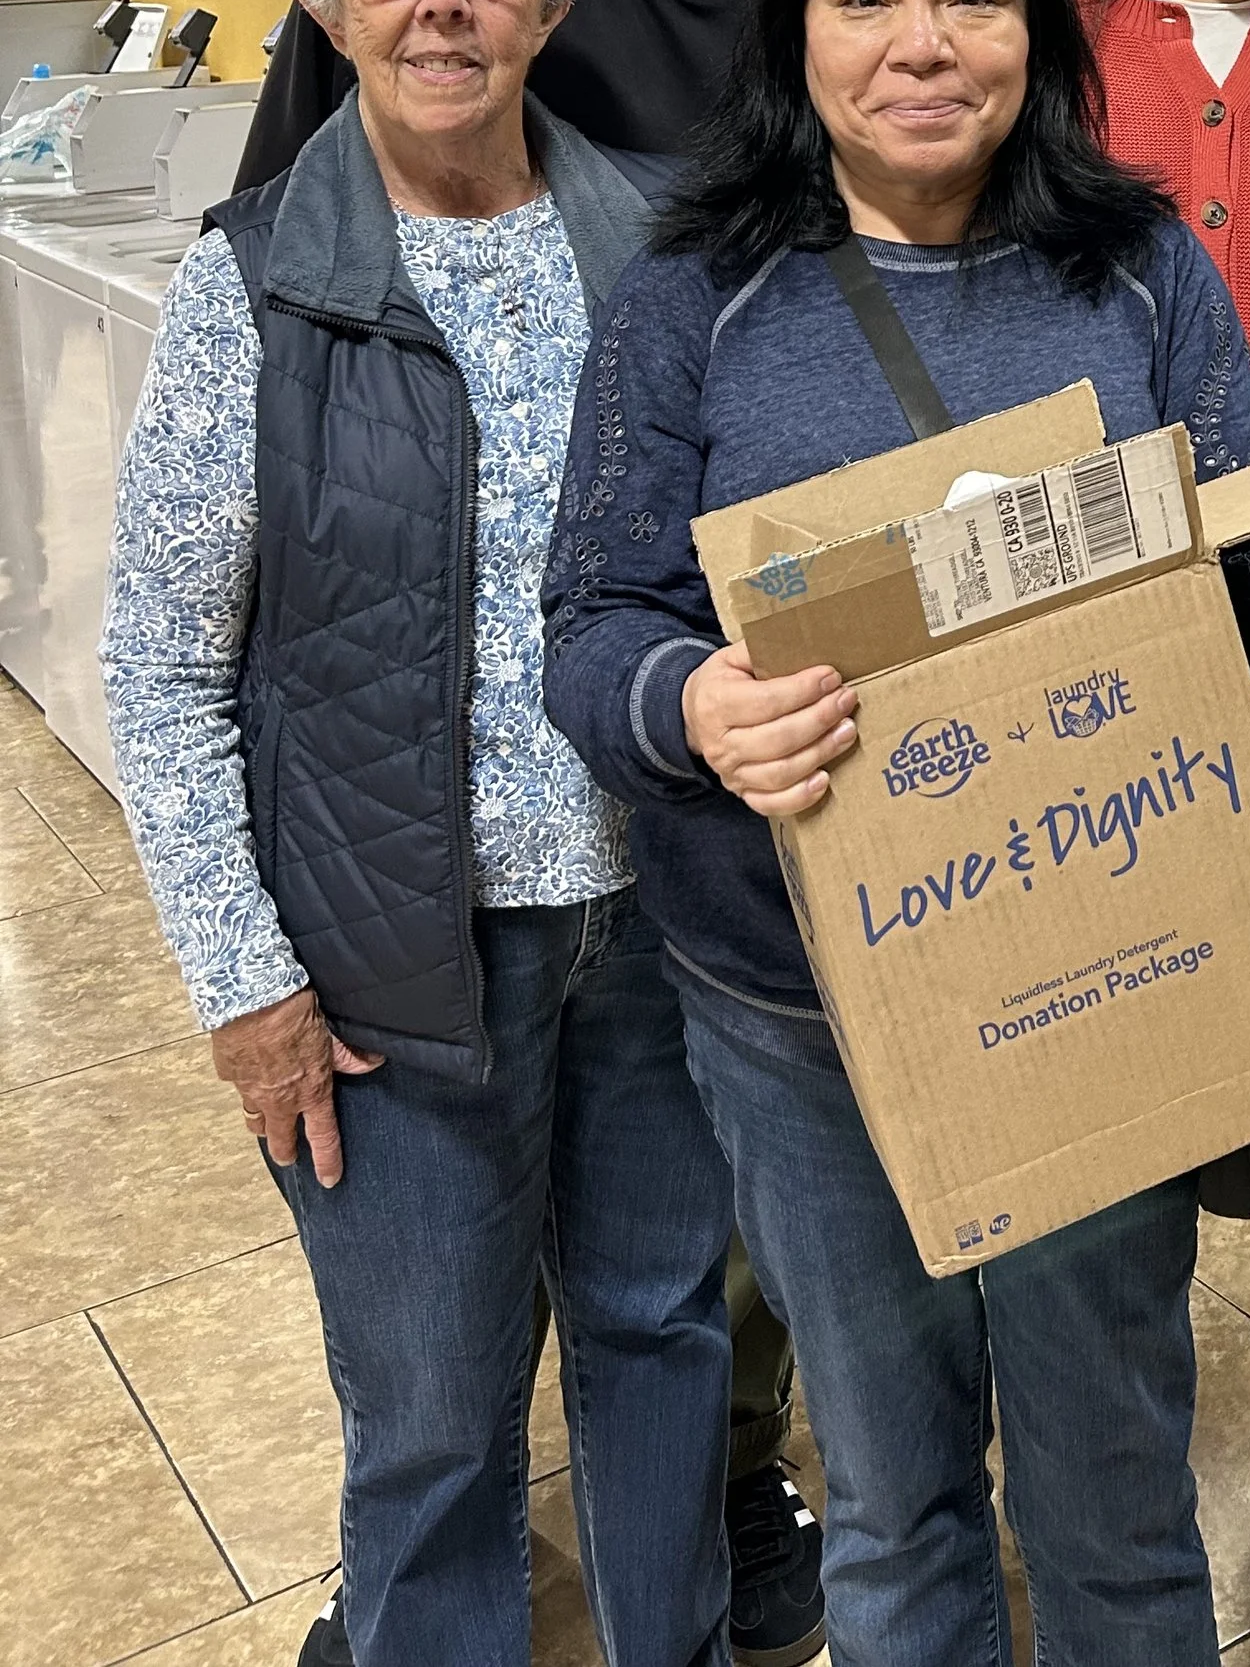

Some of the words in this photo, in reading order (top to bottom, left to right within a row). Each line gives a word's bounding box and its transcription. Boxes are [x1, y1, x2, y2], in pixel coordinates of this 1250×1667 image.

[997, 490, 1015, 515] 0-20
[1002, 516, 1020, 536] 930
[1007, 535, 1023, 553] CA
[1057, 524, 1073, 563] GROUND
[975, 557, 985, 569] CA
[1065, 564, 1077, 583] UPS
[979, 570, 993, 603] VENTURA
[1044, 668, 1119, 707] laundry
[1048, 680, 1136, 739] LOVE
[890, 718, 977, 770] earth
[882, 742, 991, 797] breeze
[856, 853, 996, 947] Love
[1007, 819, 1036, 891] &
[1038, 735, 1241, 876] Dignity
[1001, 975, 1064, 1008] Liquidless
[1065, 955, 1115, 983] Laundry
[1117, 928, 1179, 961] Detergent
[978, 987, 1102, 1050] Donation
[1104, 941, 1214, 998] Package
[992, 1217, 1009, 1231] he
